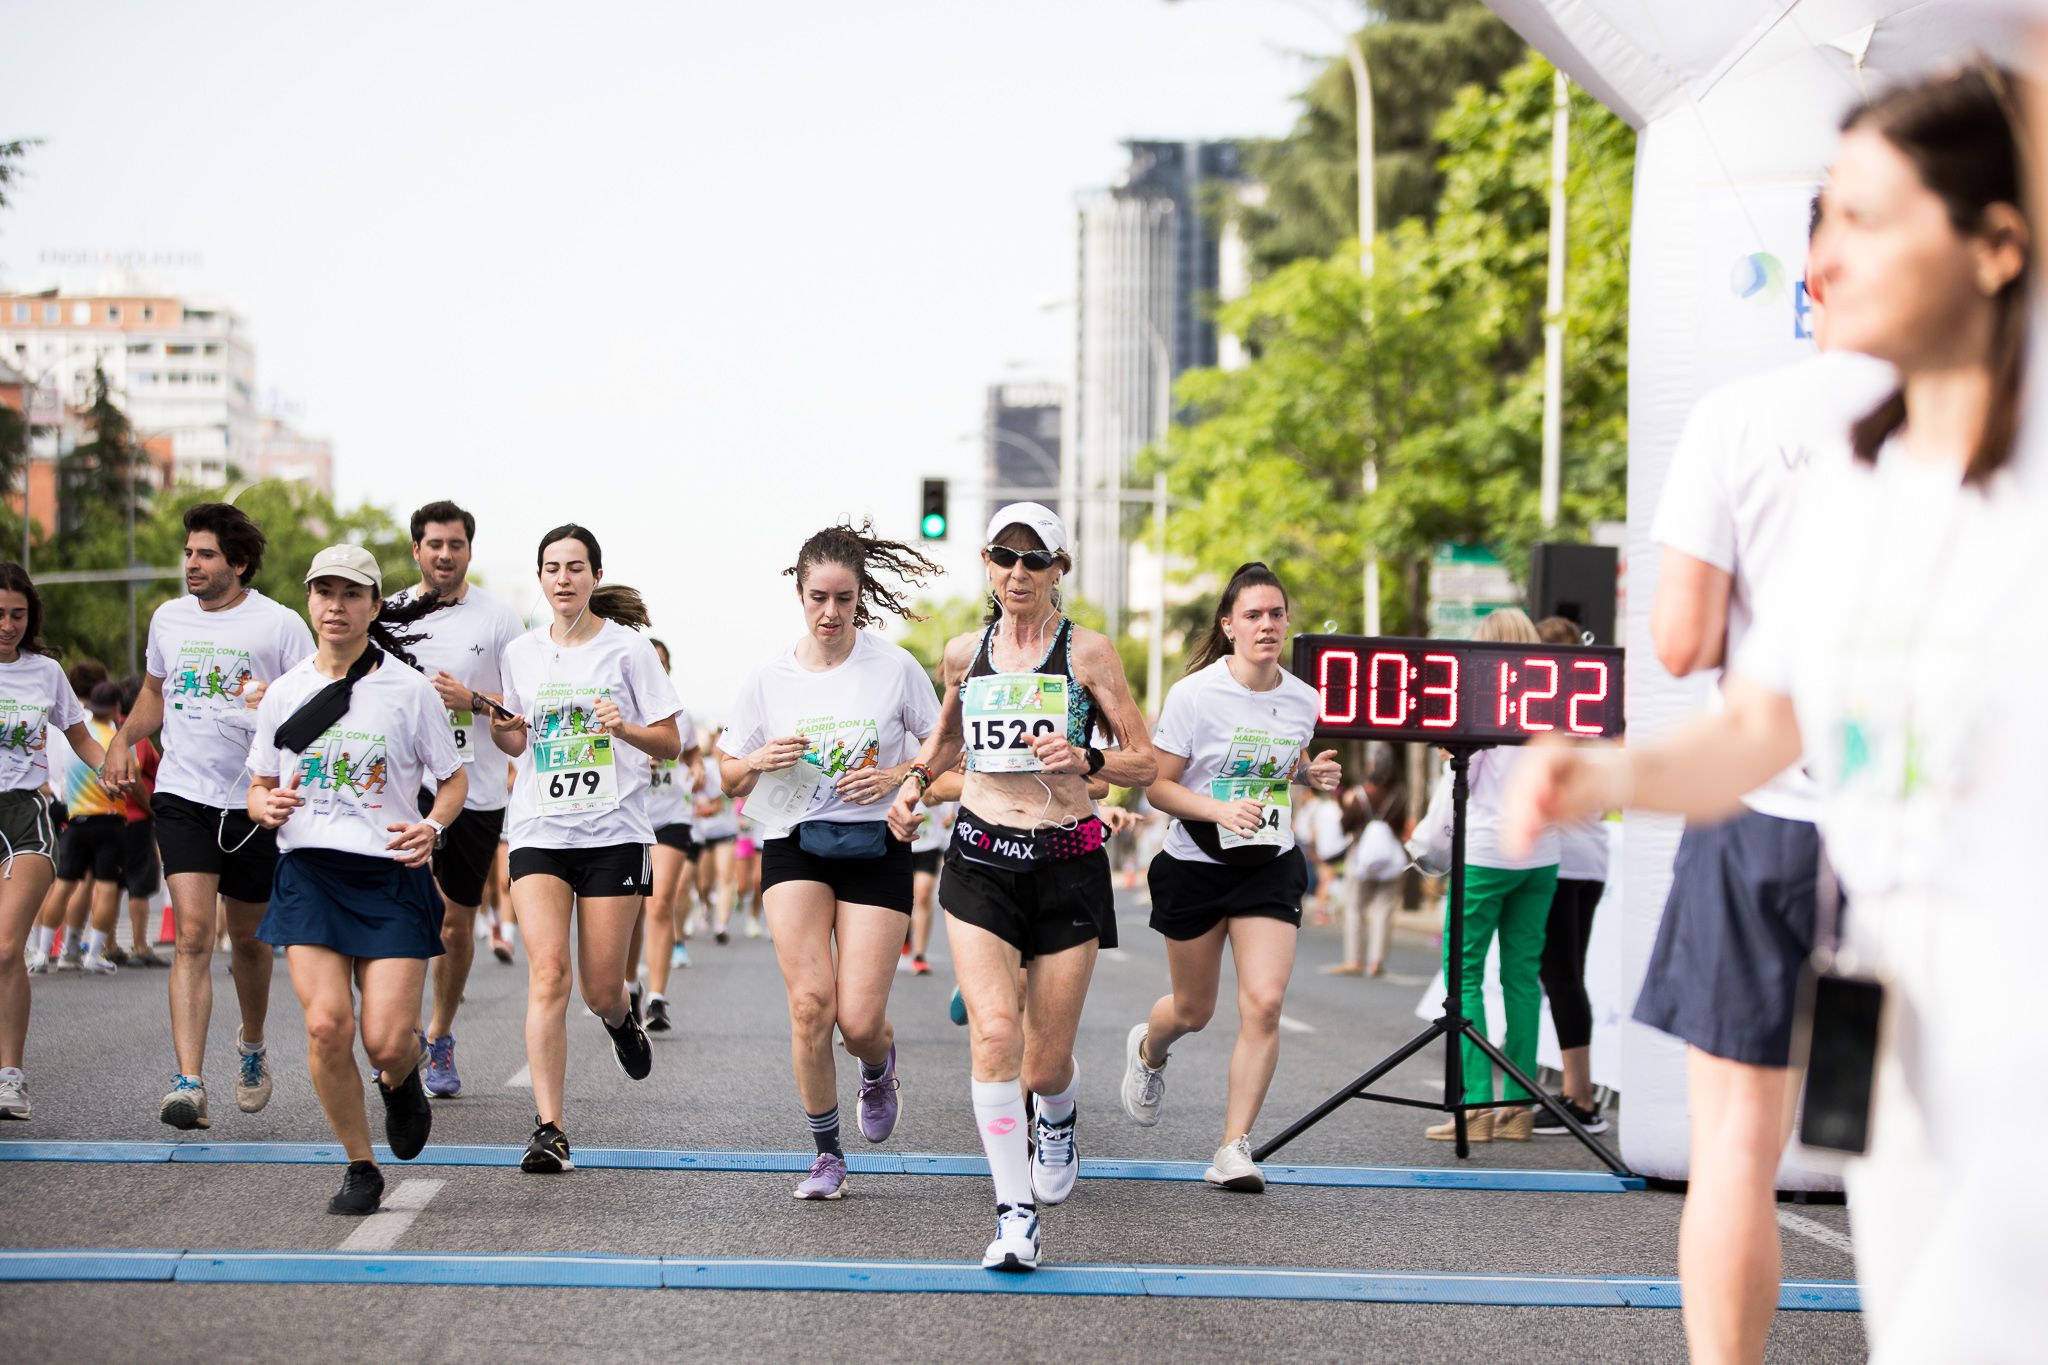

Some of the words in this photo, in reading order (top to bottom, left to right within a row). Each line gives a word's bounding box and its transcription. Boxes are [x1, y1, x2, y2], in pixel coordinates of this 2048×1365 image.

[180, 646, 215, 654] MADRID
[217, 647, 236, 656] CON
[238, 650, 250, 658] LA
[982, 684, 1042, 710] ELA
[345, 731, 369, 740] CON
[795, 722, 836, 735] MADRID
[838, 719, 860, 728] CON
[1233, 735, 1271, 744] MADRID
[1272, 737, 1291, 746] CON
[549, 744, 595, 768] ELA
[549, 770, 601, 798] 679
[992, 838, 1036, 861] MAX
